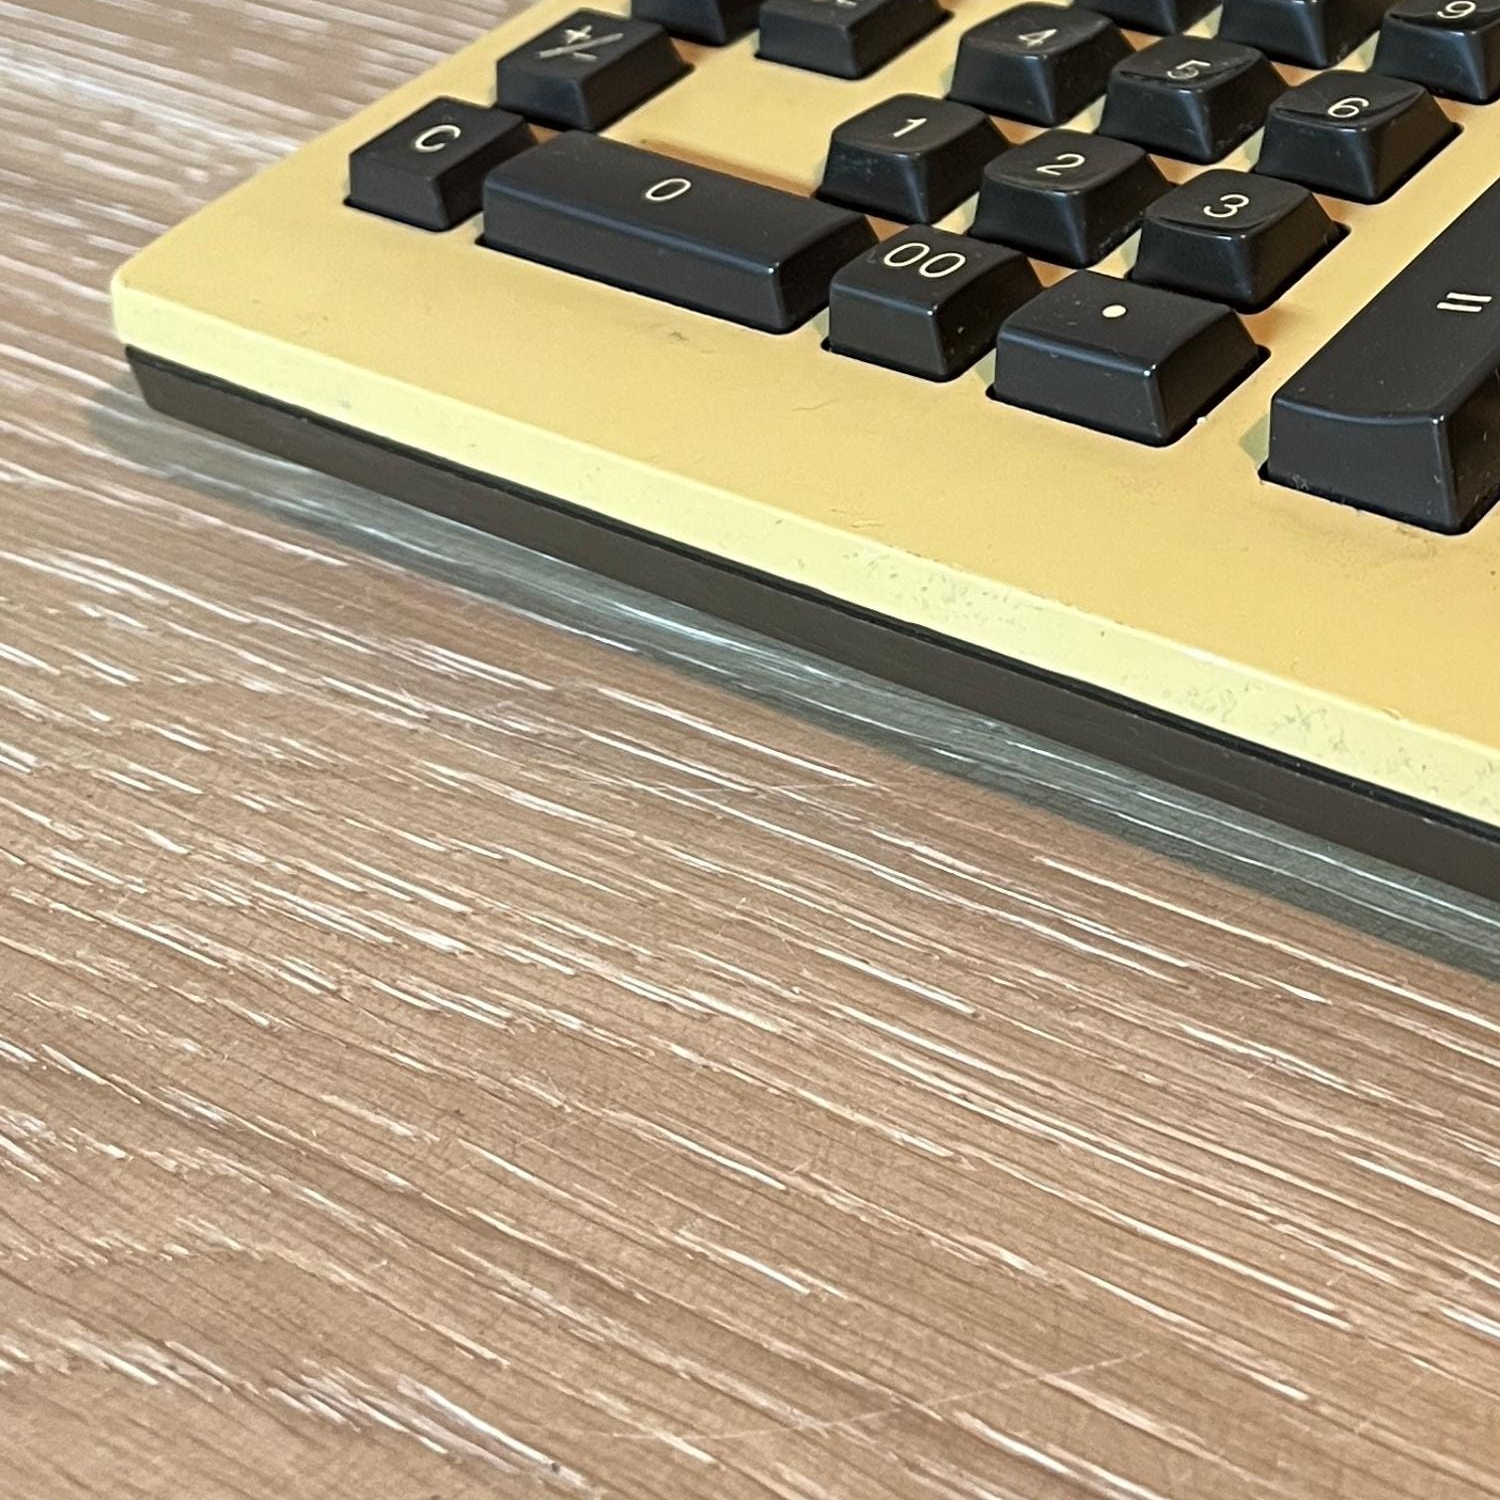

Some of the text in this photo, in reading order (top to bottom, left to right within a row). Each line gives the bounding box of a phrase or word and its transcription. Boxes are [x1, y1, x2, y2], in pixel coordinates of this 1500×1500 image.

[1436, 0, 1477, 19] 9
[1018, 28, 1057, 47] 4
[1166, 59, 1211, 80] 5
[1327, 97, 1370, 118] 6
[414, 124, 461, 152] C
[893, 117, 927, 138] 1
[1035, 153, 1086, 176] 2
[644, 178, 692, 202] 0
[1203, 194, 1250, 218] 3
